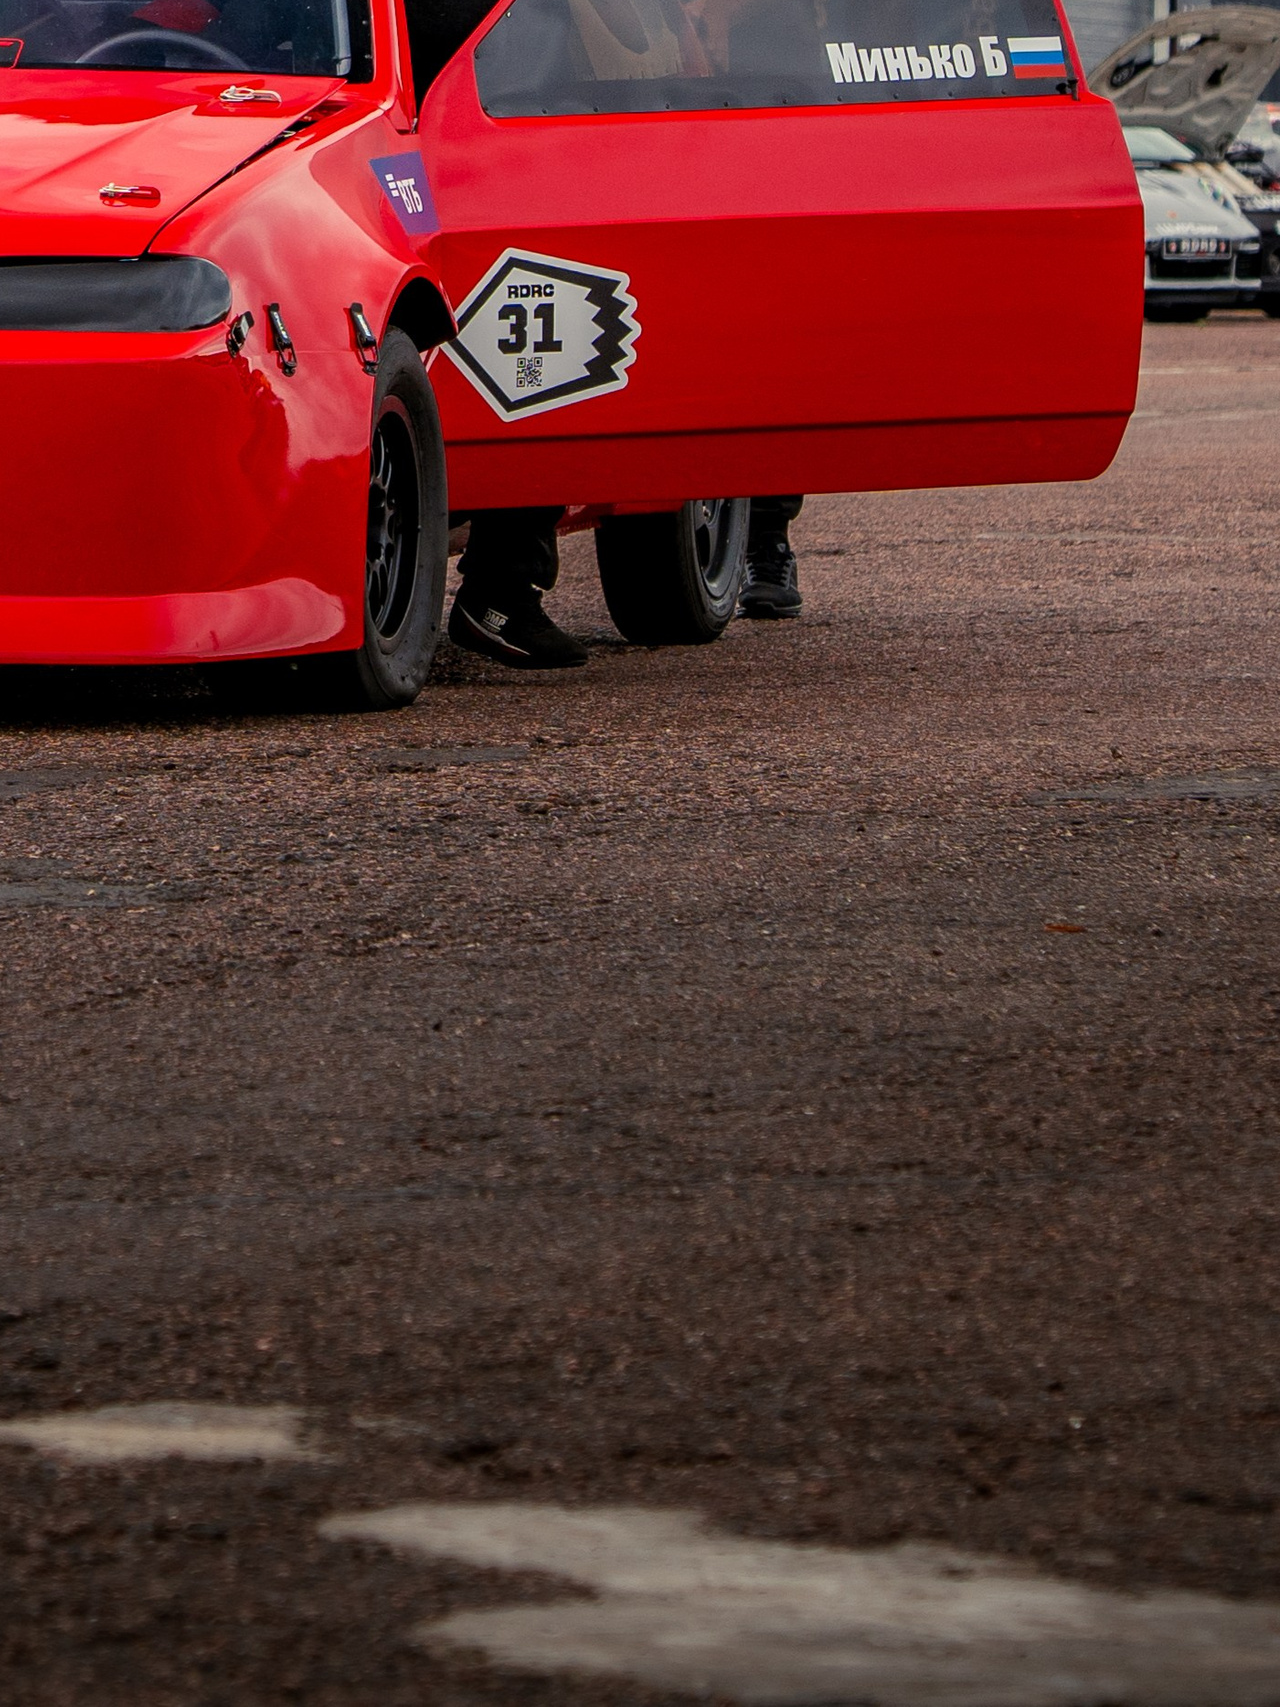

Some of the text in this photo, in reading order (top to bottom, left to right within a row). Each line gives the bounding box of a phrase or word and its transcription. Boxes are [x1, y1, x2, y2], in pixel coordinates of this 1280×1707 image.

[826, 36, 1008, 84] Минько Б
[396, 177, 423, 214] ВТБ
[507, 283, 555, 298] RDRC
[498, 303, 563, 355] 31
[484, 610, 507, 627] OMP
